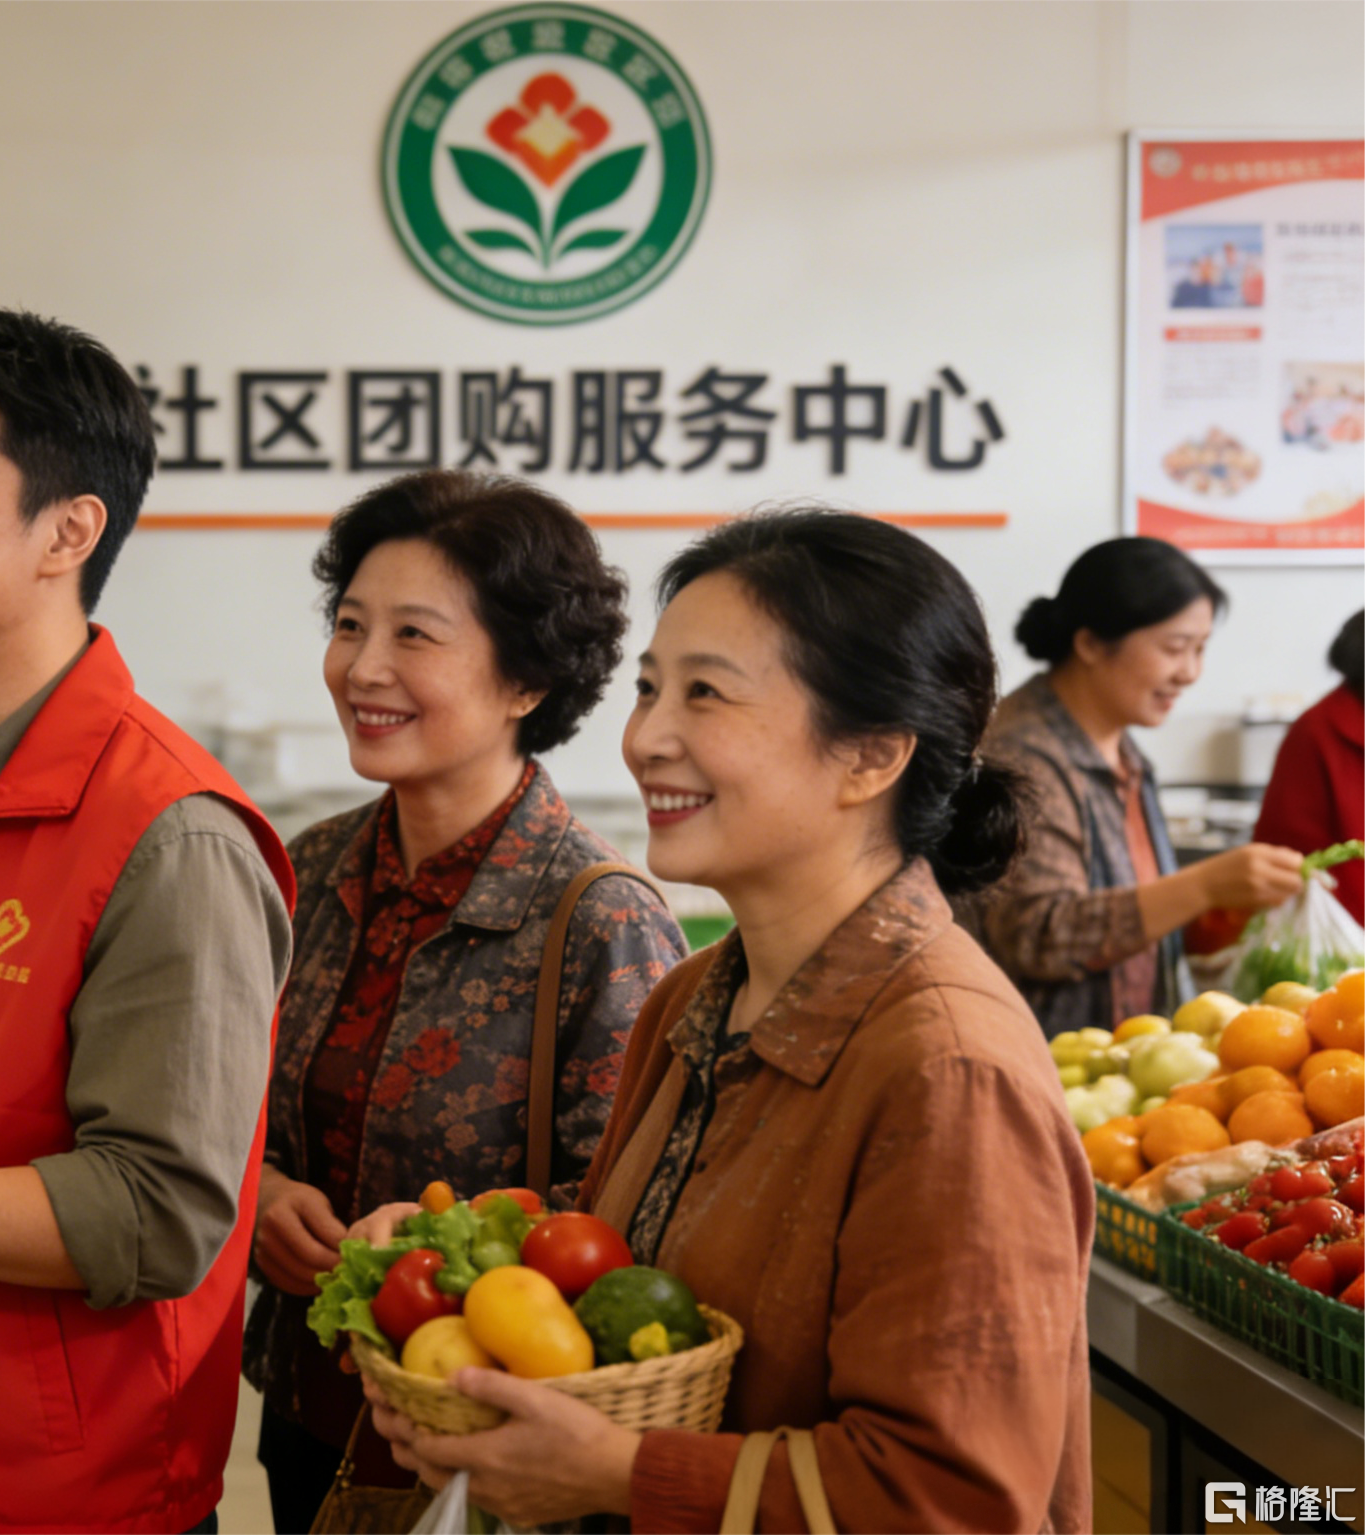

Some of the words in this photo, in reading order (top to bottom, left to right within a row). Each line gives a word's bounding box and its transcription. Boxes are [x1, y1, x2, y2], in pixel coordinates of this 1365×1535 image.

[137, 364, 1005, 474] 社区团购服务中心
